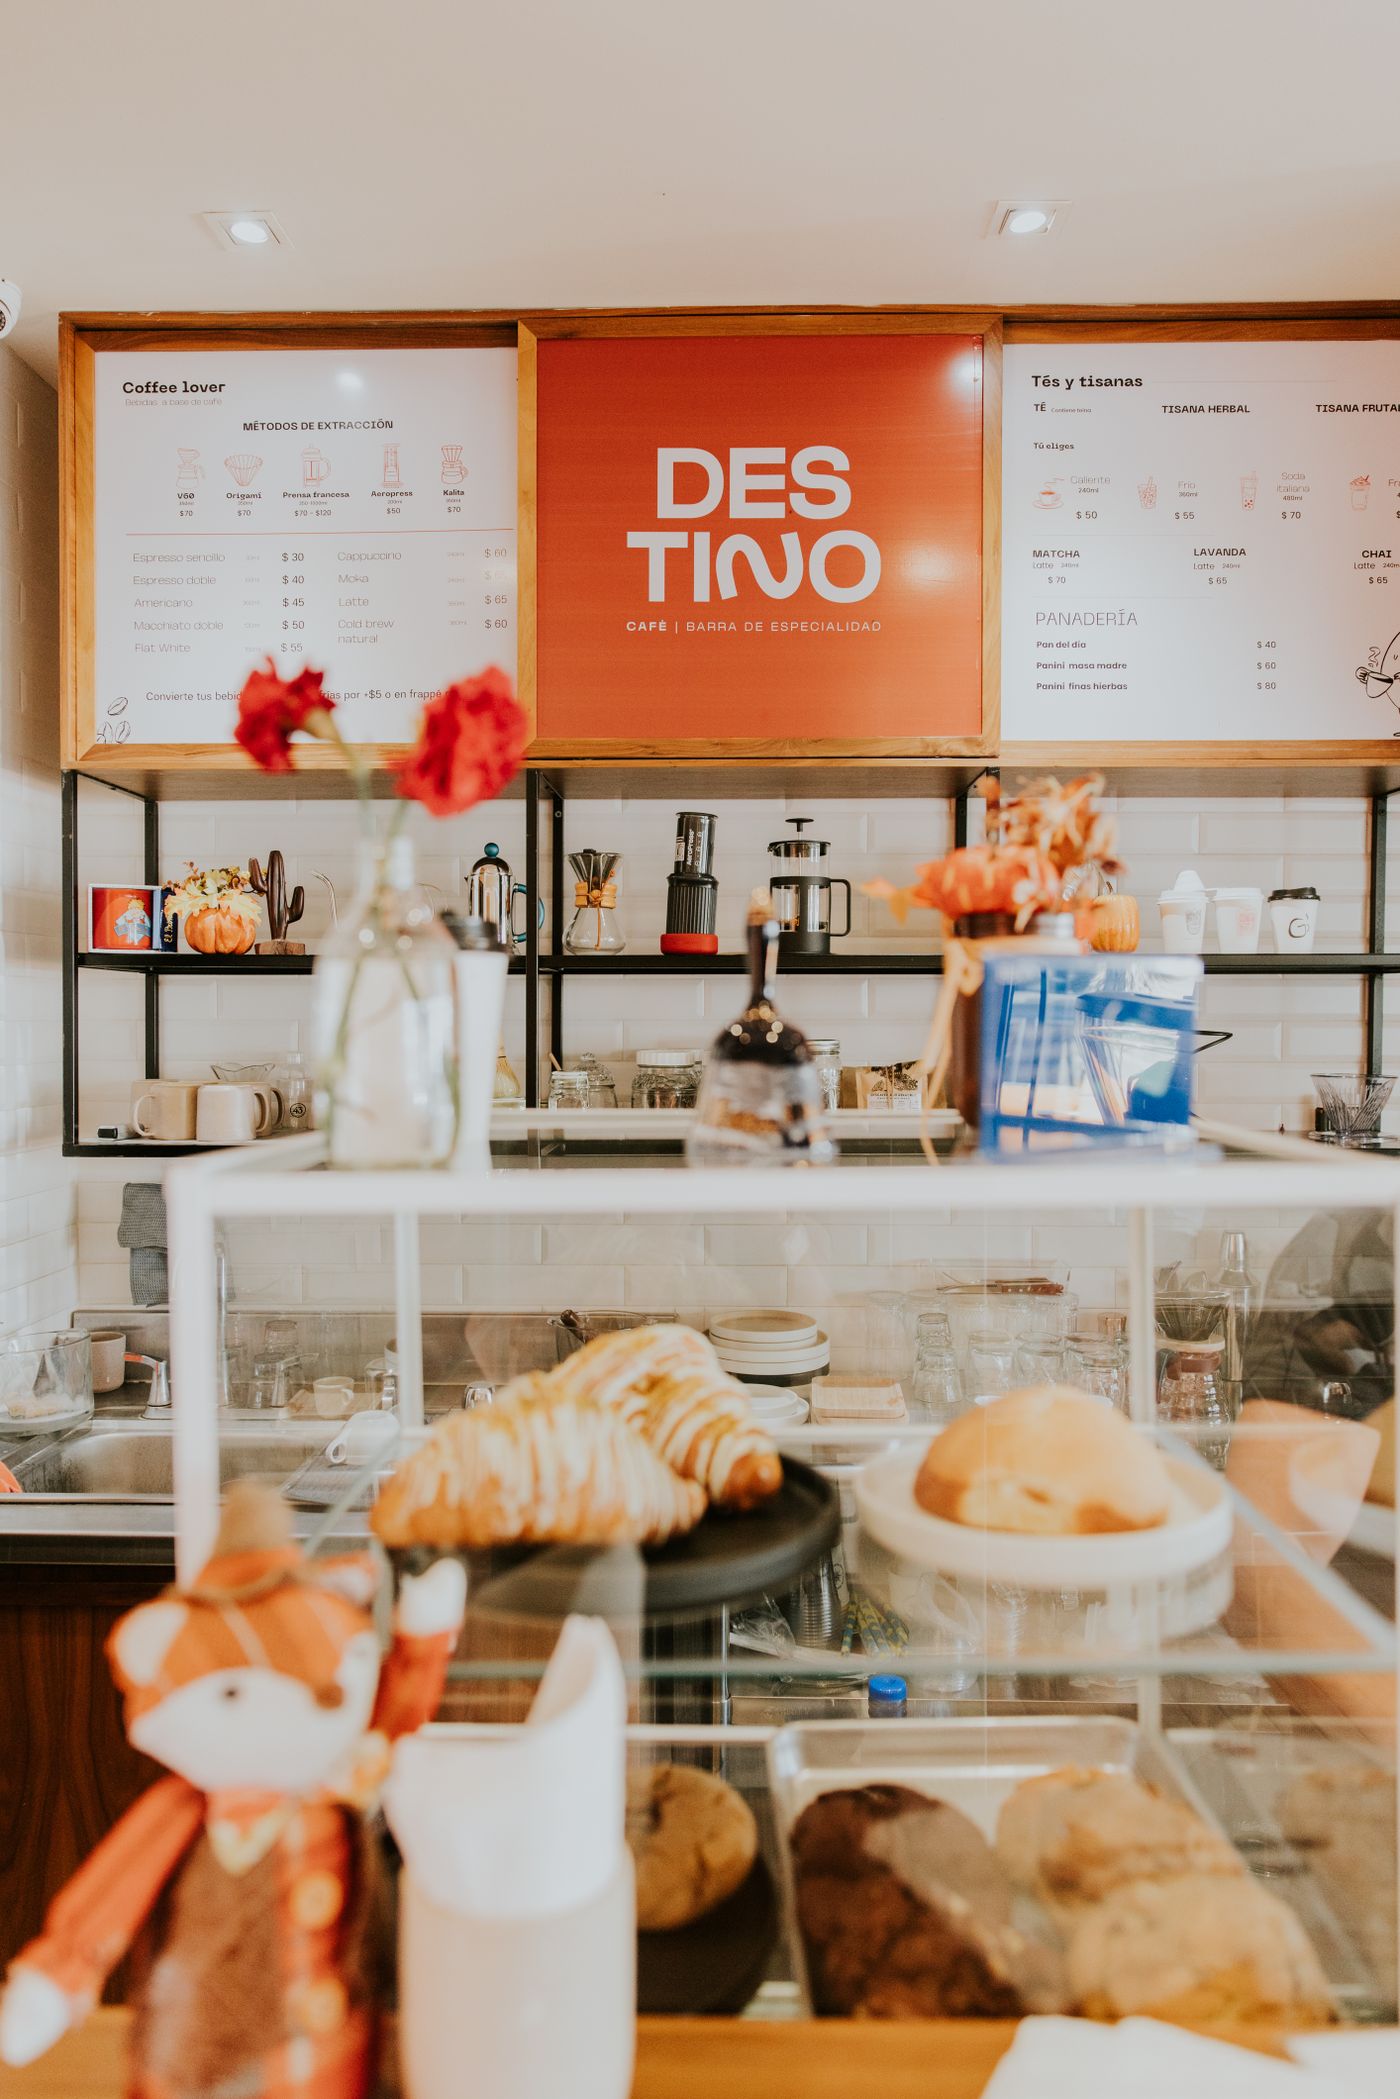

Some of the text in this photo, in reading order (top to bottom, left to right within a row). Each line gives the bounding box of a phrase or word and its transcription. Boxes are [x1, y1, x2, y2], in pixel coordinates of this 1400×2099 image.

[122, 381, 226, 393] Coffee lover
[1032, 375, 1143, 390] Tés y tisanas
[1033, 401, 1047, 412] TÉ
[1162, 405, 1251, 414] TISANA HERBAL
[1316, 404, 1359, 413] TISANA
[243, 419, 393, 431] MÉTODOS DE EXTRACCIÓN
[657, 446, 851, 520] DES
[177, 492, 195, 500] V60
[226, 492, 262, 501] Origami
[371, 490, 413, 498] Aeropress
[443, 488, 465, 496] Kalita
[386, 507, 401, 515] $50
[1085, 511, 1098, 519] 50
[1183, 512, 1195, 520] 55
[1290, 512, 1301, 520] 70
[281, 552, 304, 562] $ 30
[1032, 550, 1080, 558] MATCHA
[1193, 548, 1247, 557] LAVANDA
[1361, 550, 1392, 558] CHAI
[133, 552, 226, 564] Espresso sencillo
[627, 529, 881, 603] TINO
[1032, 561, 1054, 569] Latte
[1193, 562, 1215, 570] Latte
[1353, 562, 1376, 570] Latte
[133, 575, 217, 586] Espresso doble
[282, 575, 305, 585] $ 40
[338, 574, 369, 583] Moka
[1056, 576, 1066, 584] 70
[134, 598, 193, 608] Americano
[282, 597, 305, 607] $ 45
[338, 597, 369, 607] Latte
[494, 595, 508, 604] 65
[1035, 609, 1138, 626] PANADERÍA
[134, 621, 224, 631] Macchiato doble
[282, 620, 305, 630] $ 50
[337, 619, 394, 629] Cold brew
[494, 620, 508, 629] 60
[626, 619, 881, 632] CAFÉ BARRA DE ESPECIALIDAD
[337, 634, 378, 644] natural
[134, 643, 191, 653] Flat White
[290, 643, 303, 653] 55
[1036, 641, 1054, 649] Pan
[1056, 640, 1070, 649] del
[1265, 641, 1276, 649] 40
[1036, 661, 1127, 670] Panini masa madre
[1265, 662, 1276, 670] 60
[1036, 682, 1128, 690] Panini finas hierbas
[1265, 682, 1276, 690] 80
[146, 691, 195, 701] Convierte
[197, 691, 212, 701] tus
[343, 692, 361, 701] por
[385, 691, 391, 699] o
[394, 691, 407, 699] en
[410, 689, 441, 701] frappé
